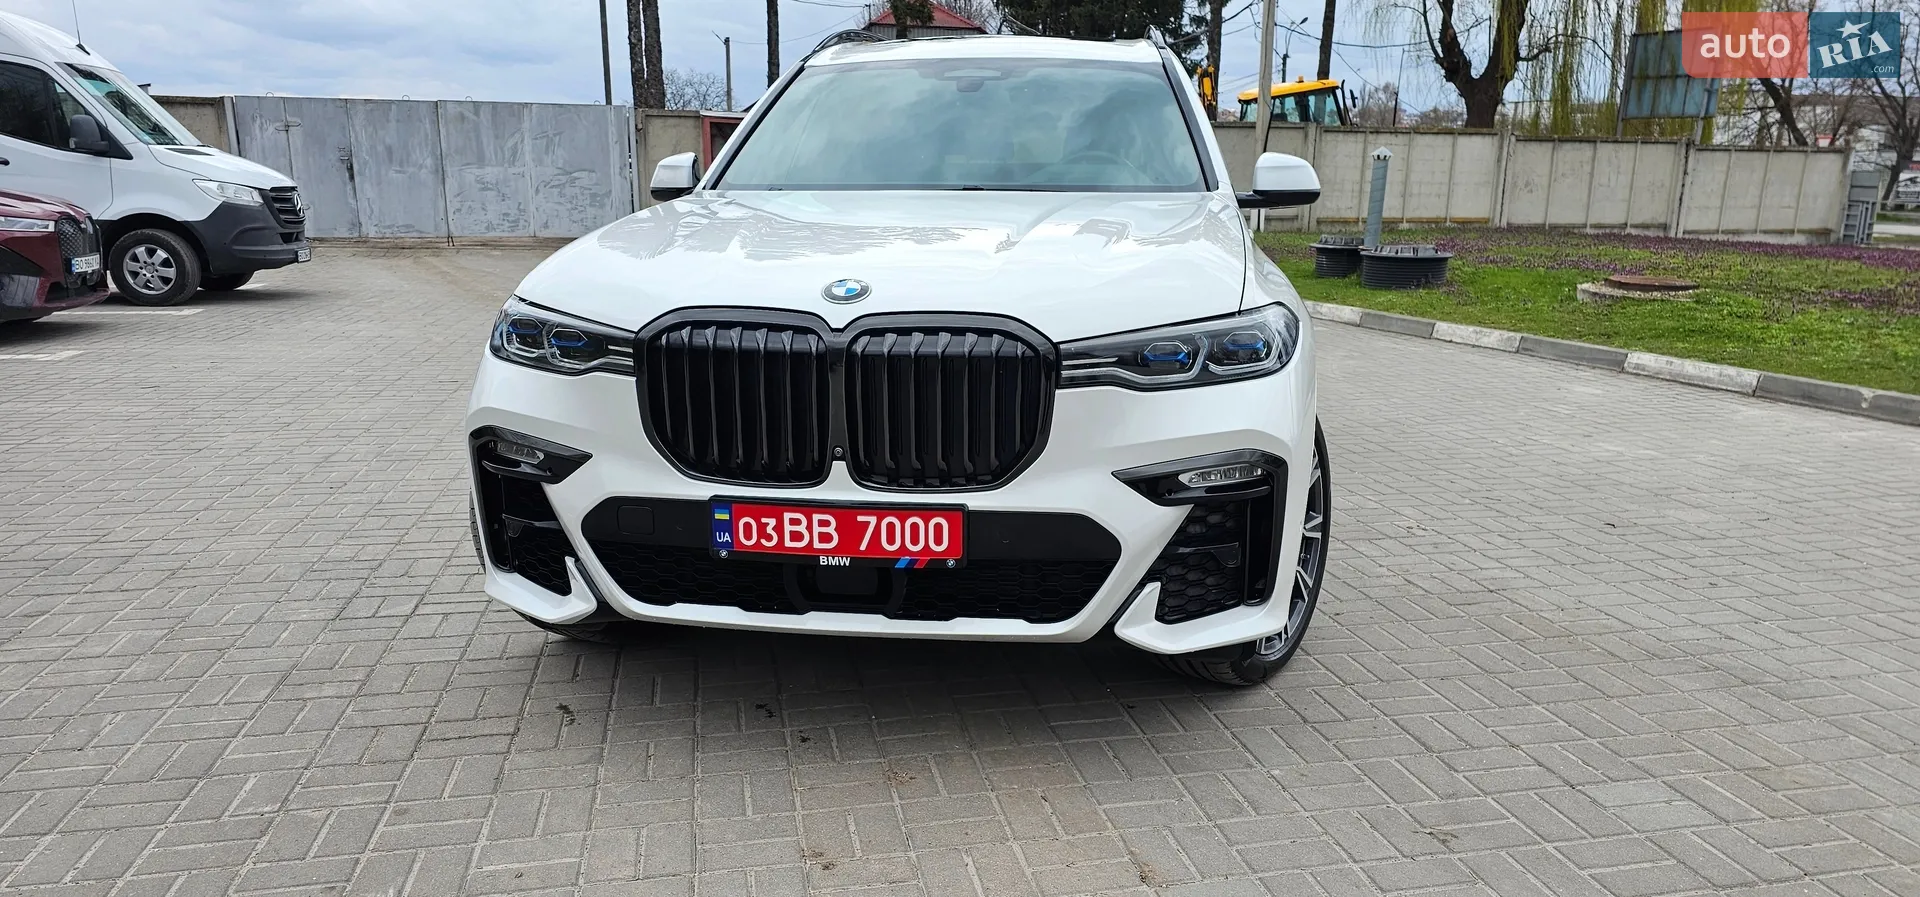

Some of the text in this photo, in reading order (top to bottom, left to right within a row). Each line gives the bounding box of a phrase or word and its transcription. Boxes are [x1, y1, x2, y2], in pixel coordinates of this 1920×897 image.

[716, 531, 731, 543] UA
[856, 515, 949, 552] 7000
[819, 555, 851, 567] BMW
